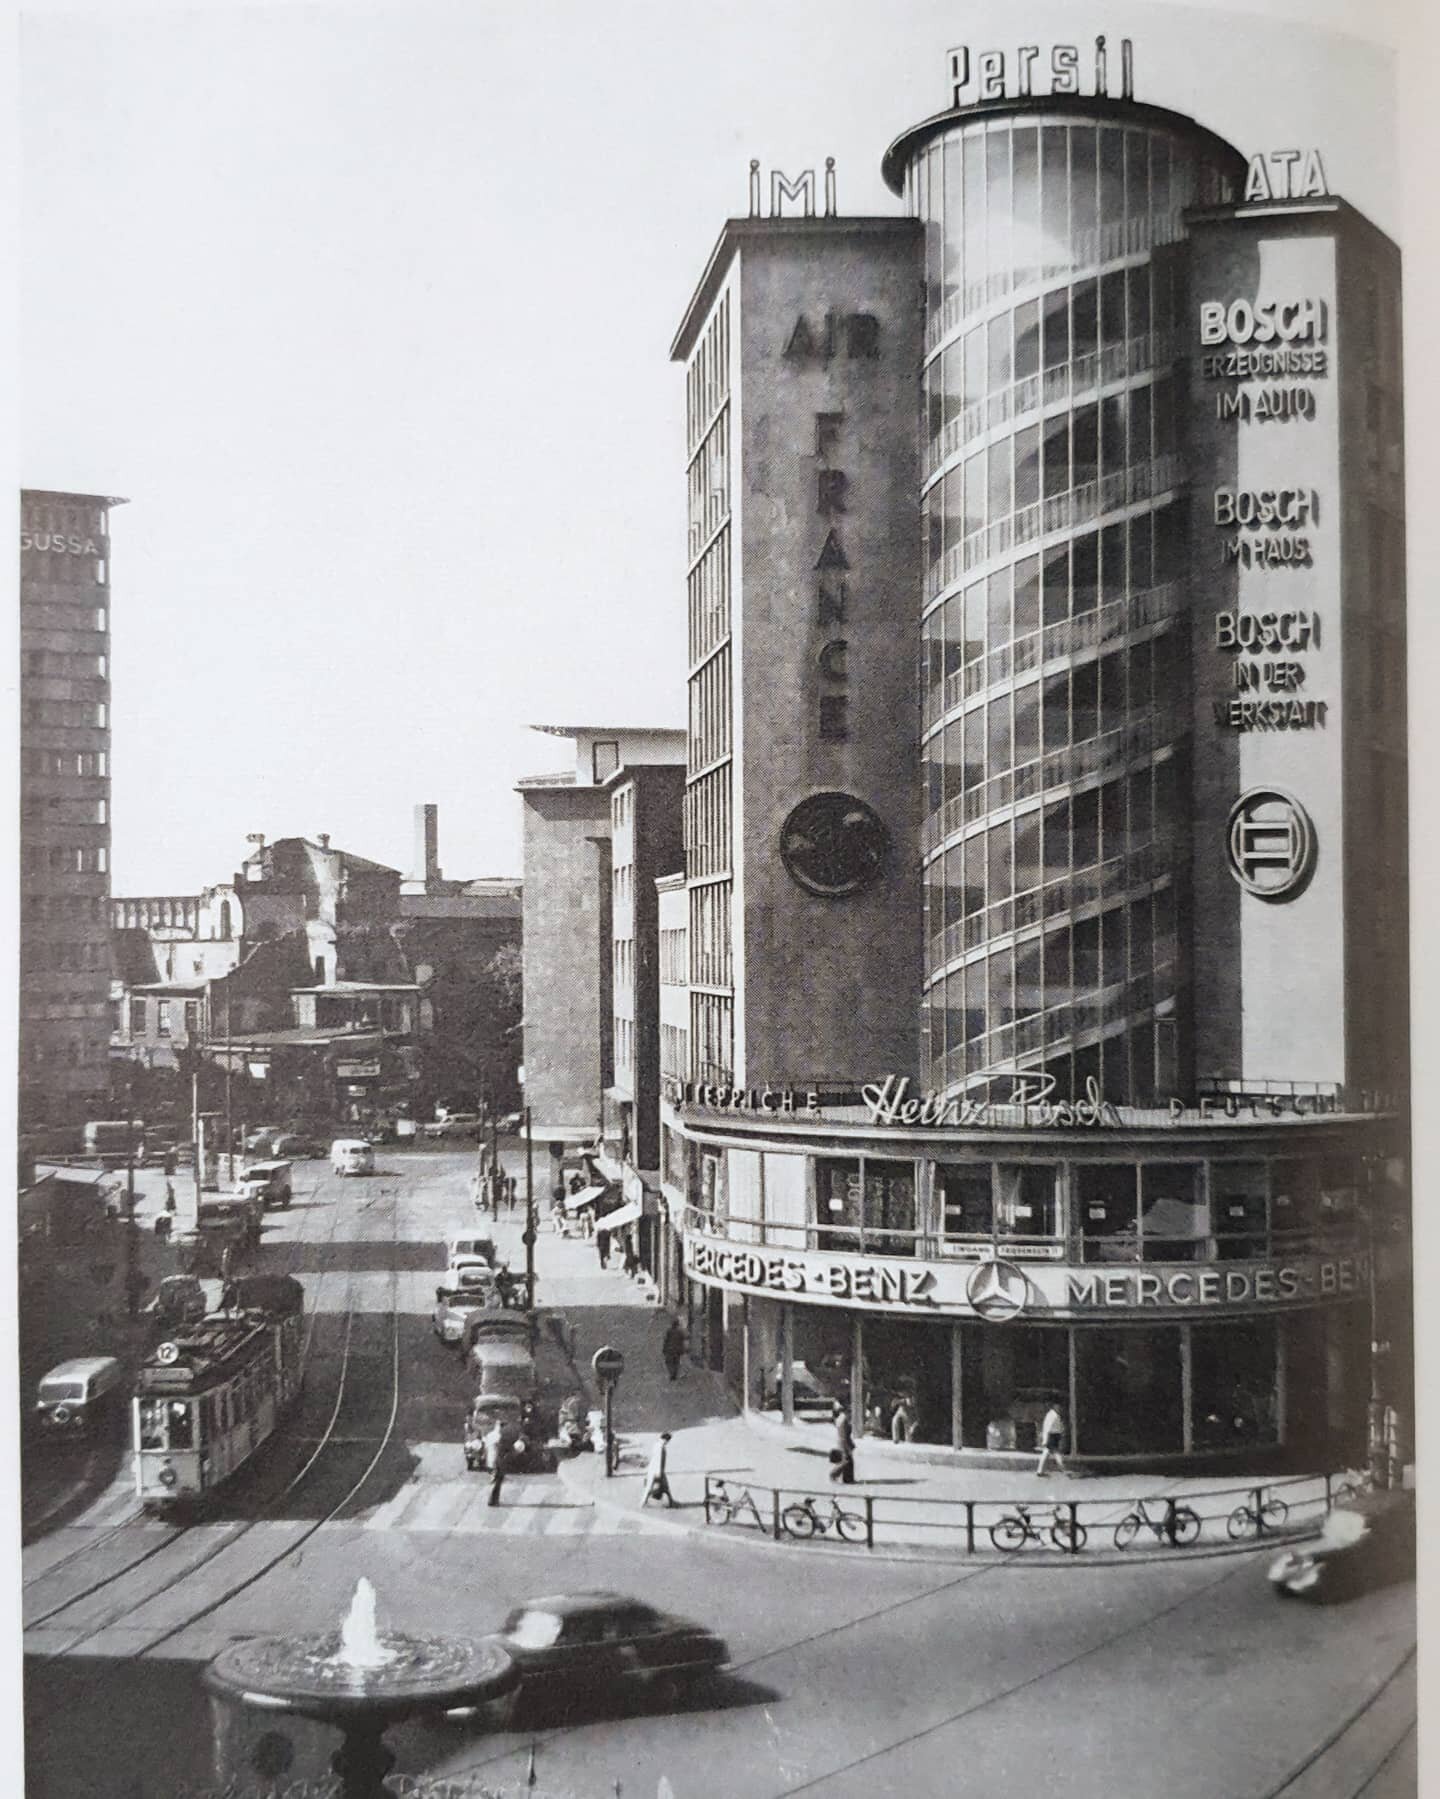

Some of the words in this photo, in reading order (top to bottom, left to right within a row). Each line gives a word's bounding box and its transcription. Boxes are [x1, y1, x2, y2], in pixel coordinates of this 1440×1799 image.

[947, 35, 1134, 108] Persil
[1244, 149, 1330, 201] ATA
[783, 312, 880, 361] AIR
[1200, 299, 1325, 345] BOSCH
[1202, 351, 1326, 378] ERZEUGNISSE
[1216, 391, 1244, 419] IM
[1255, 388, 1313, 418] AUTO
[1214, 487, 1317, 525] BOSCH
[1253, 535, 1308, 563] HAUS
[813, 411, 851, 739] FRANCE
[1215, 611, 1319, 648] BOSCH
[1233, 662, 1253, 688] IN
[1263, 661, 1301, 687] DER
[860, 1074, 988, 1126] Heinz
